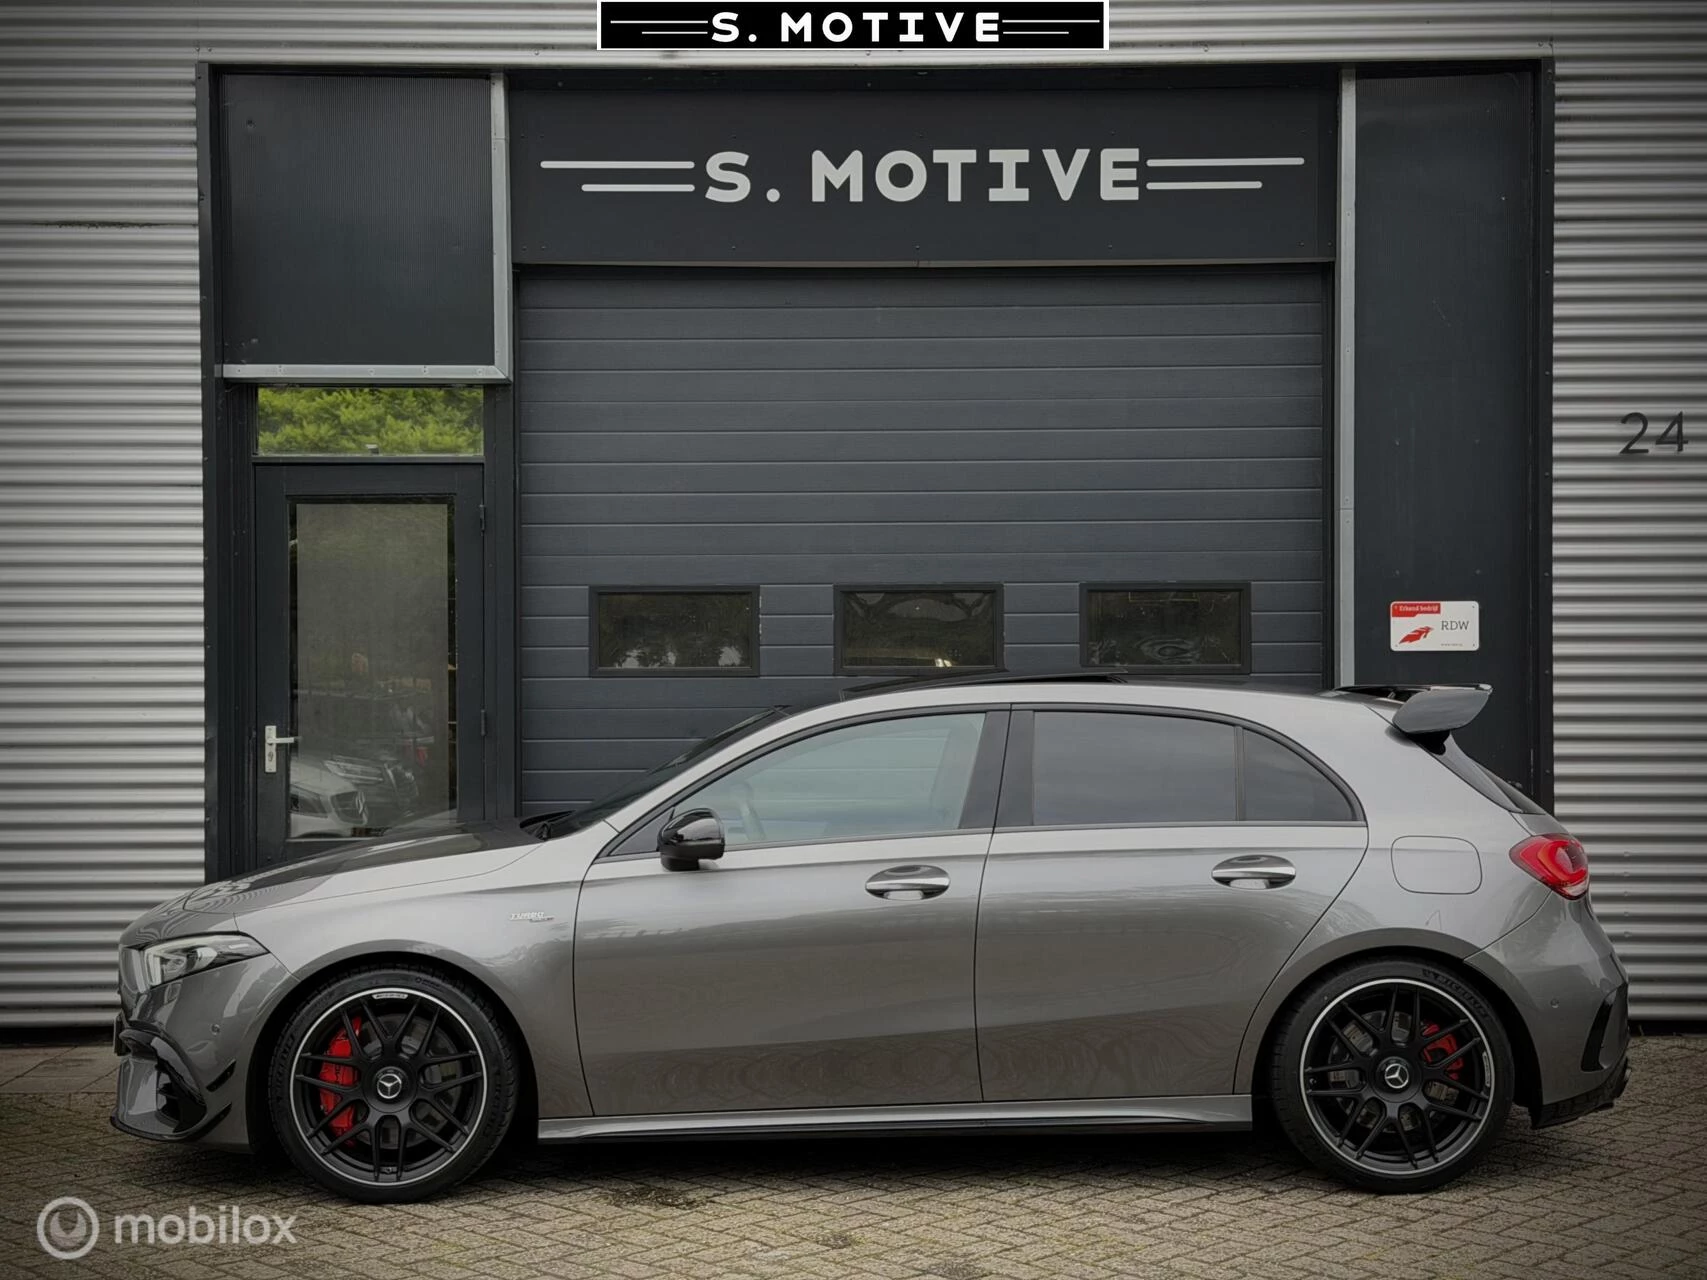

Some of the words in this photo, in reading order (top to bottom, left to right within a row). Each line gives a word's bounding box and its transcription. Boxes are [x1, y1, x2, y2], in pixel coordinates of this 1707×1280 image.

[705, 151, 780, 203] S.
[811, 148, 1140, 202] MOTIVE
[1620, 411, 1688, 454] 24
[1441, 620, 1469, 631] RDW
